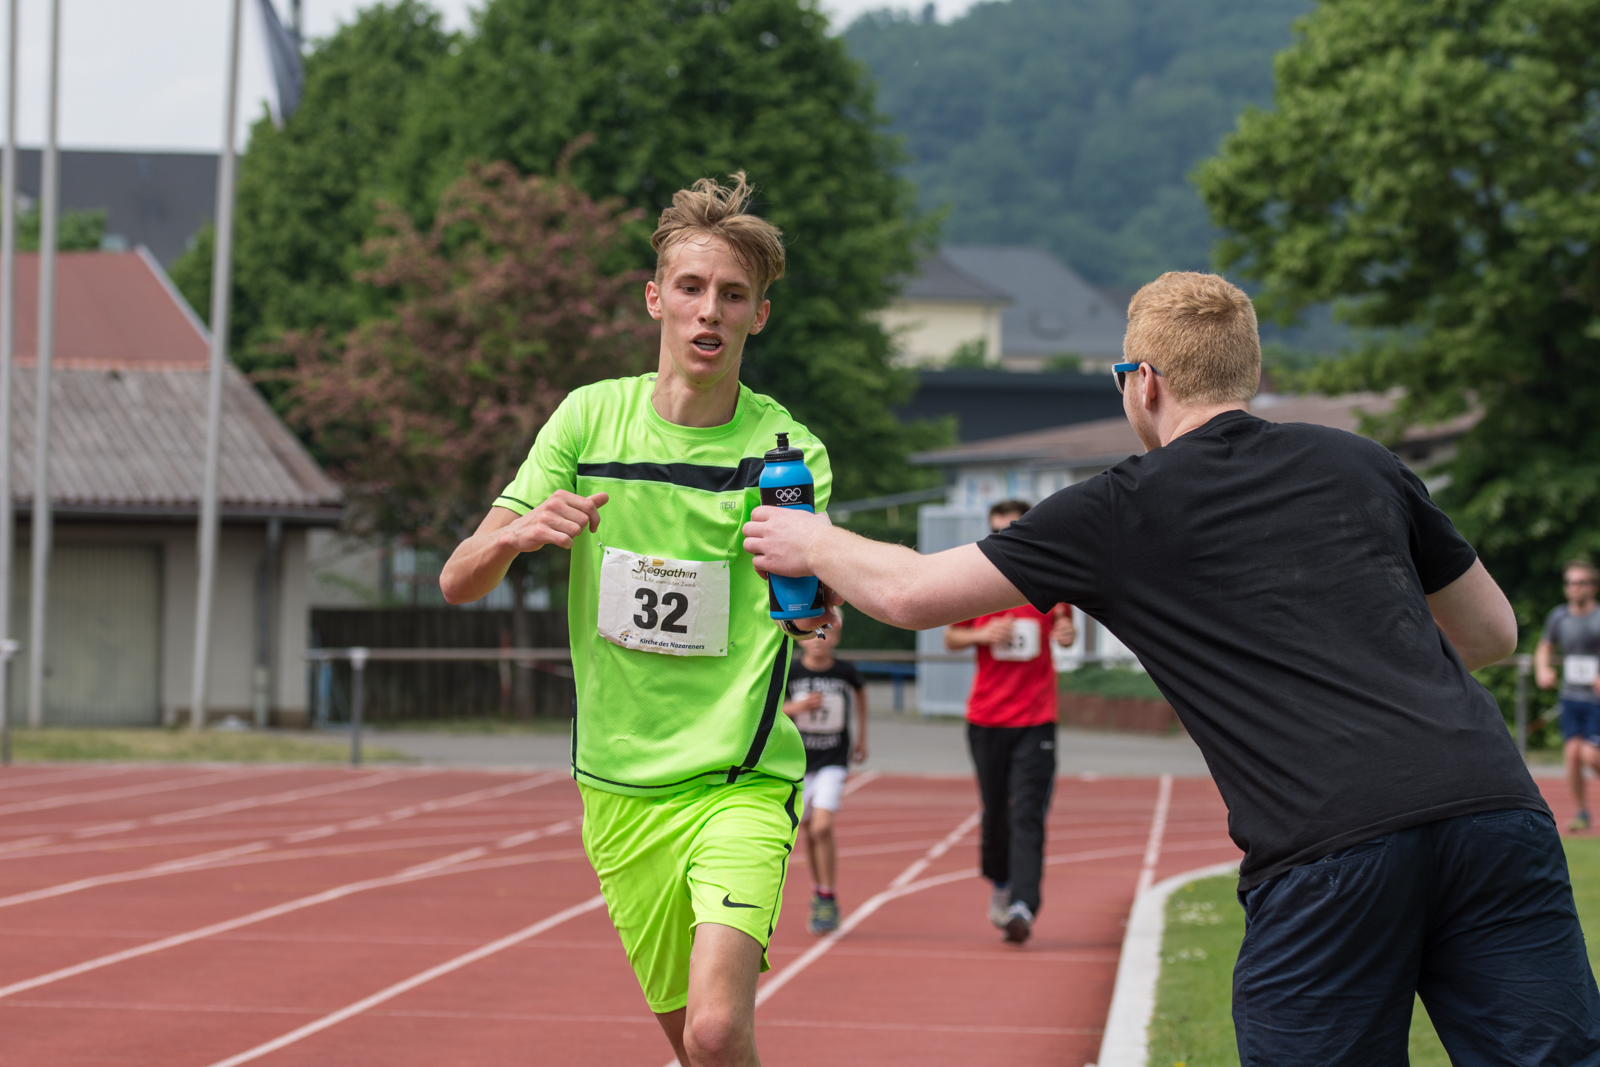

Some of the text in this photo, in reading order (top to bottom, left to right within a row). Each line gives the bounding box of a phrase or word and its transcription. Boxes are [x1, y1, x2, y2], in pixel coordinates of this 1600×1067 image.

[633, 588, 688, 633] 32
[640, 638, 657, 646] Kirche
[669, 642, 705, 650] Nazareners
